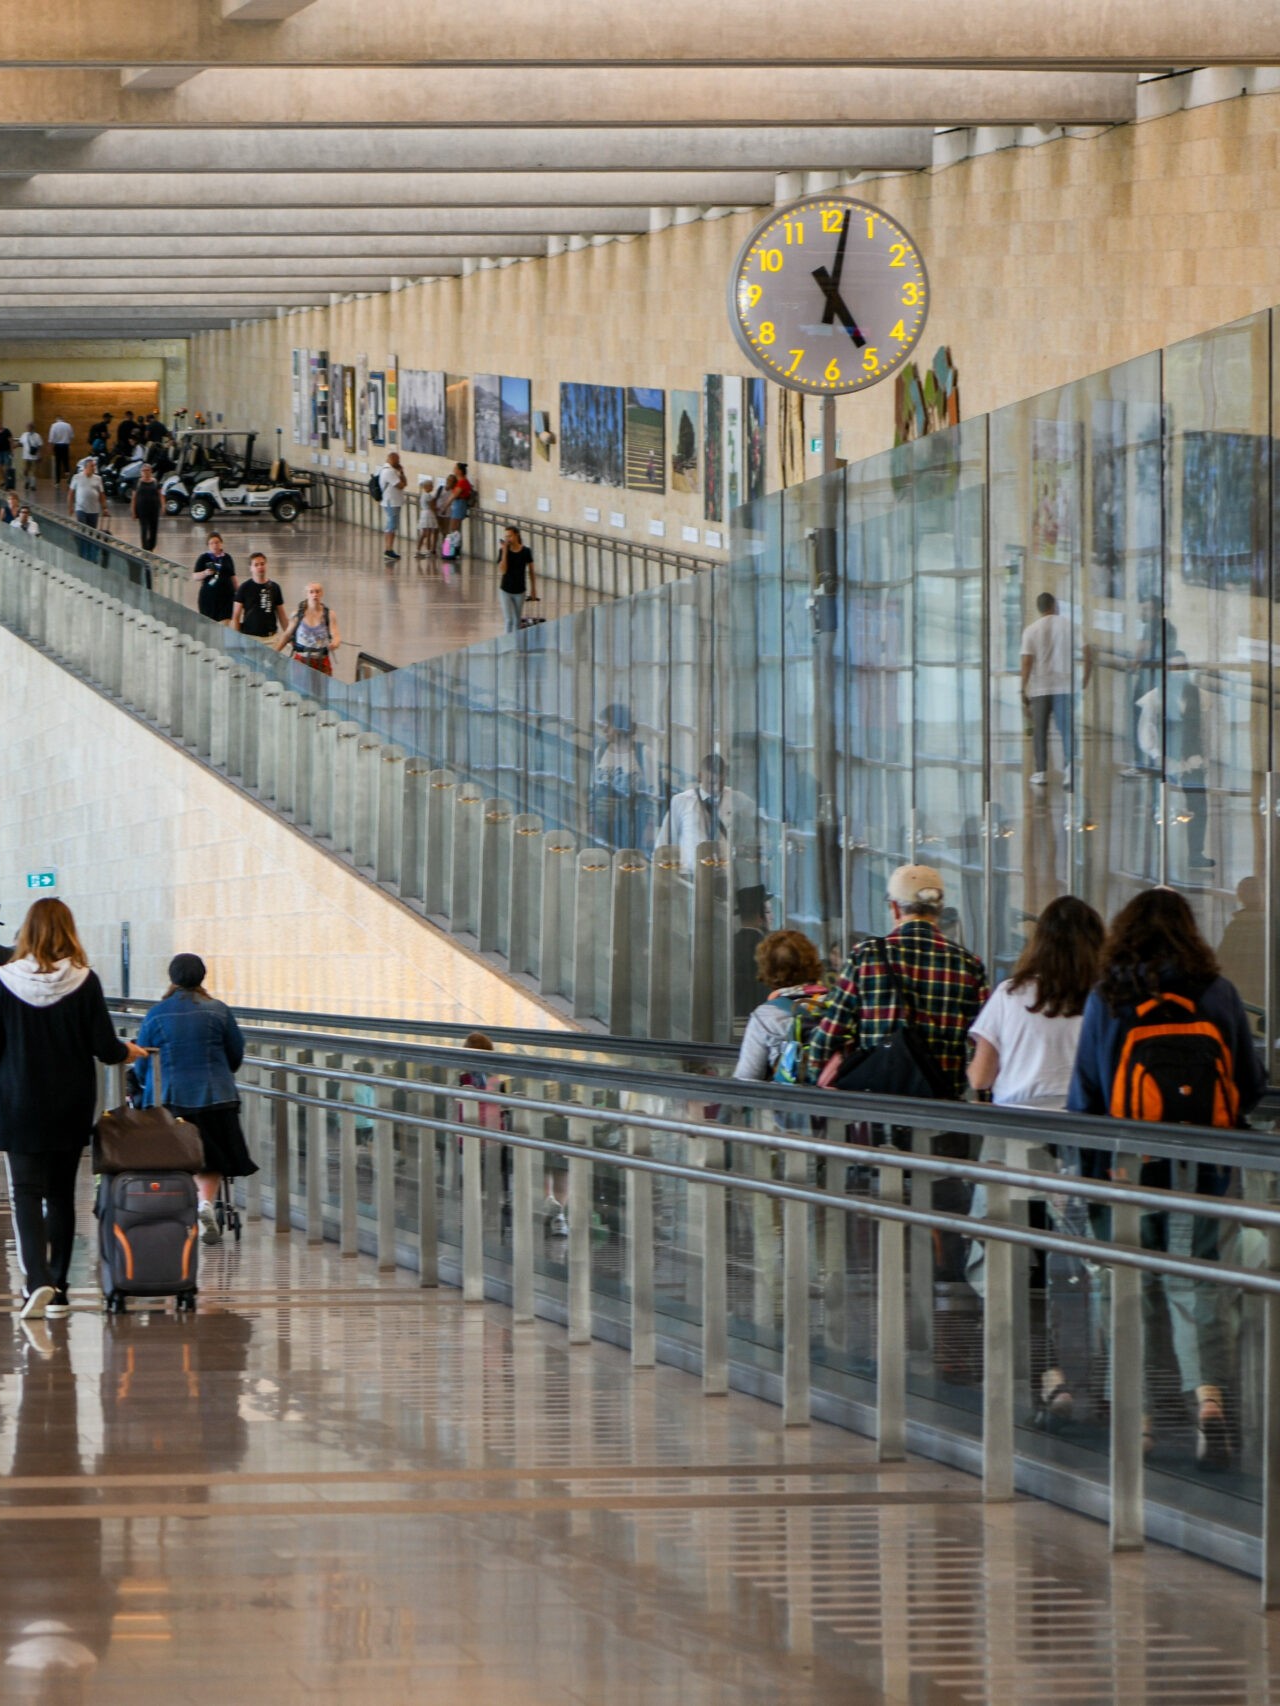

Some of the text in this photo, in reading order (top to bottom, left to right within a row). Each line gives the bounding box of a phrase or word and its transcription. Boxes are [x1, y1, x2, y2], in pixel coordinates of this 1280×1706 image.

[784, 221, 804, 245] 11
[820, 209, 843, 233] 12
[865, 216, 874, 239] 1
[758, 248, 783, 272] 10
[889, 243, 906, 267] 2
[746, 284, 762, 307] 9
[901, 282, 918, 306] 3
[758, 321, 776, 345] 8
[889, 319, 906, 341] 4
[788, 349, 805, 372] 7
[824, 358, 841, 381] 6
[862, 347, 879, 371] 5
